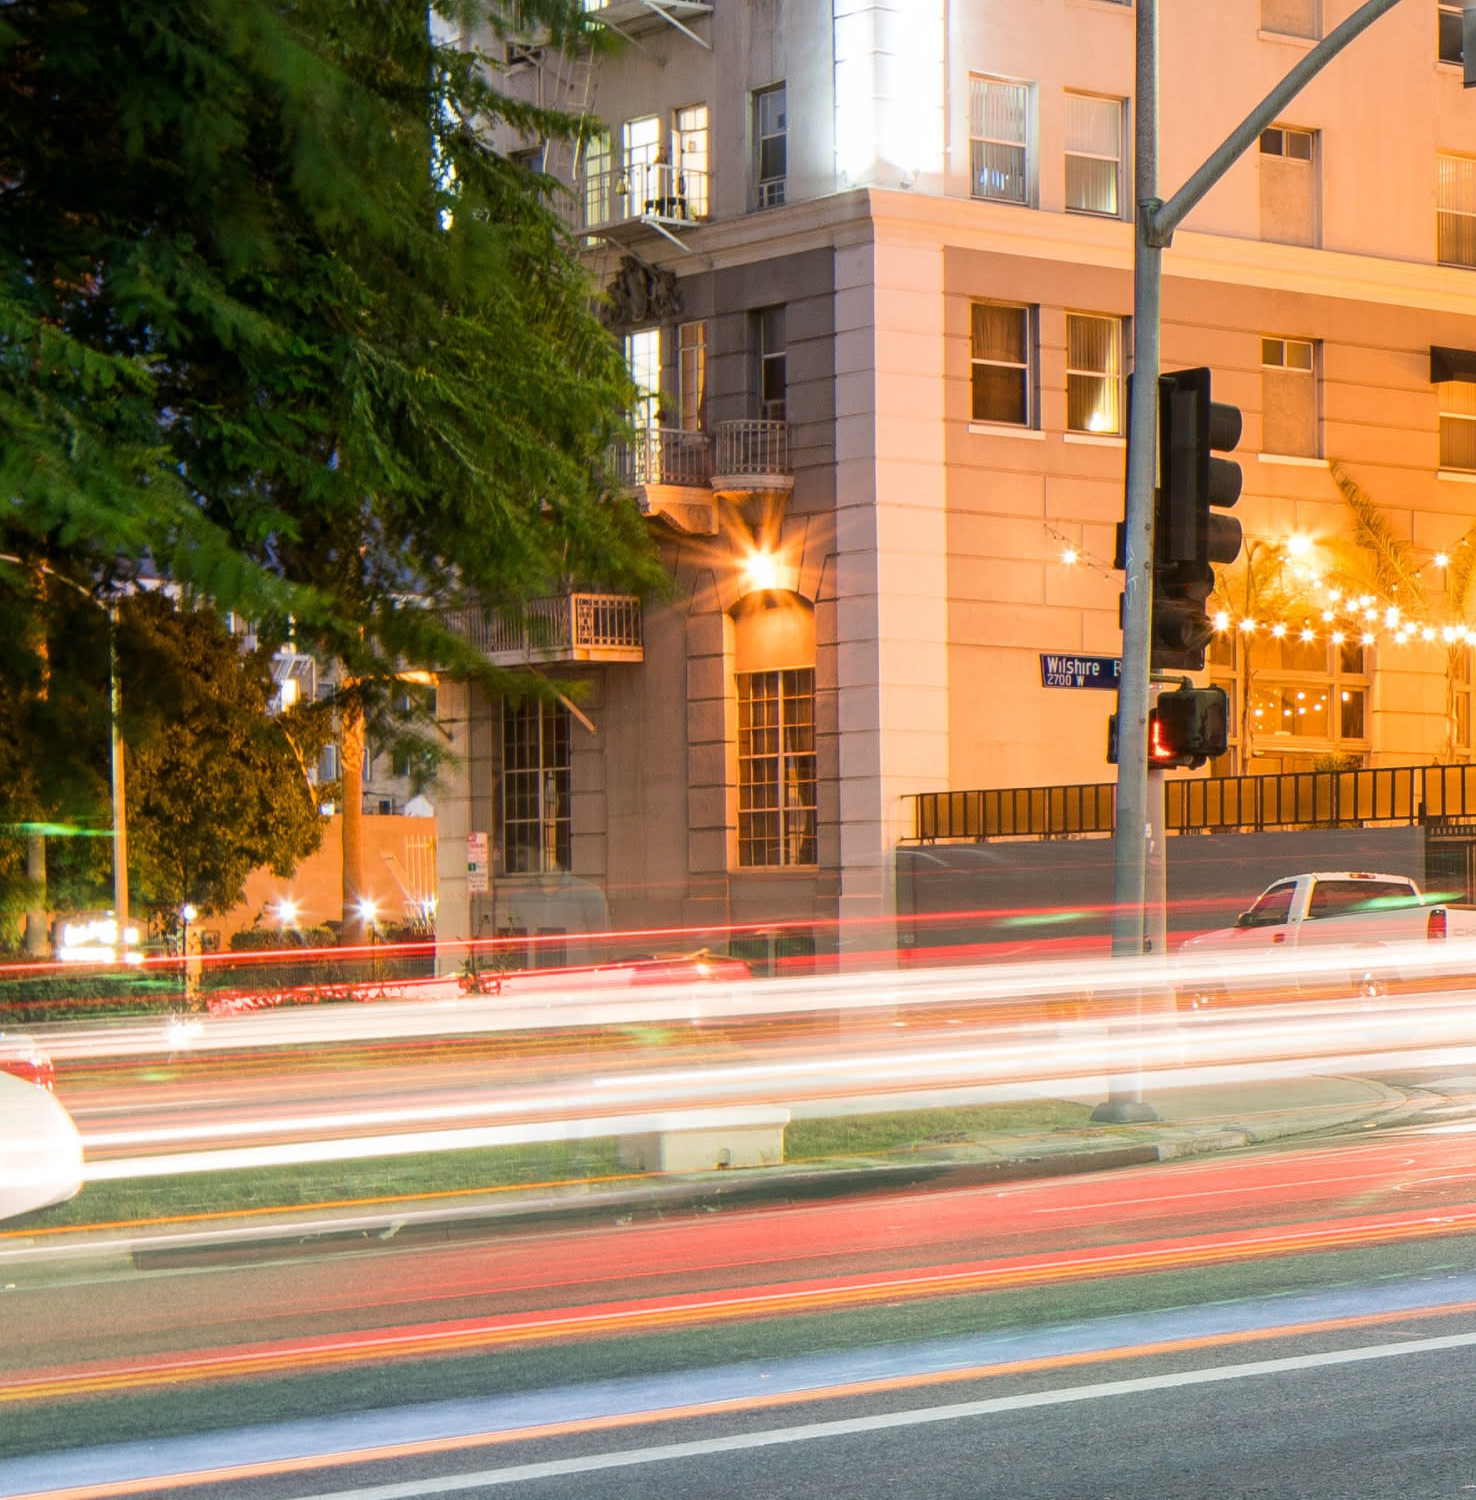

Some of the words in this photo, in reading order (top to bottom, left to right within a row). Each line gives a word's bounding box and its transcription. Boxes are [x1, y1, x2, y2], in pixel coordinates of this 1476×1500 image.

[1047, 656, 1100, 677] Wilshire
[1047, 674, 1072, 686] 2700
[1076, 676, 1085, 687] W
